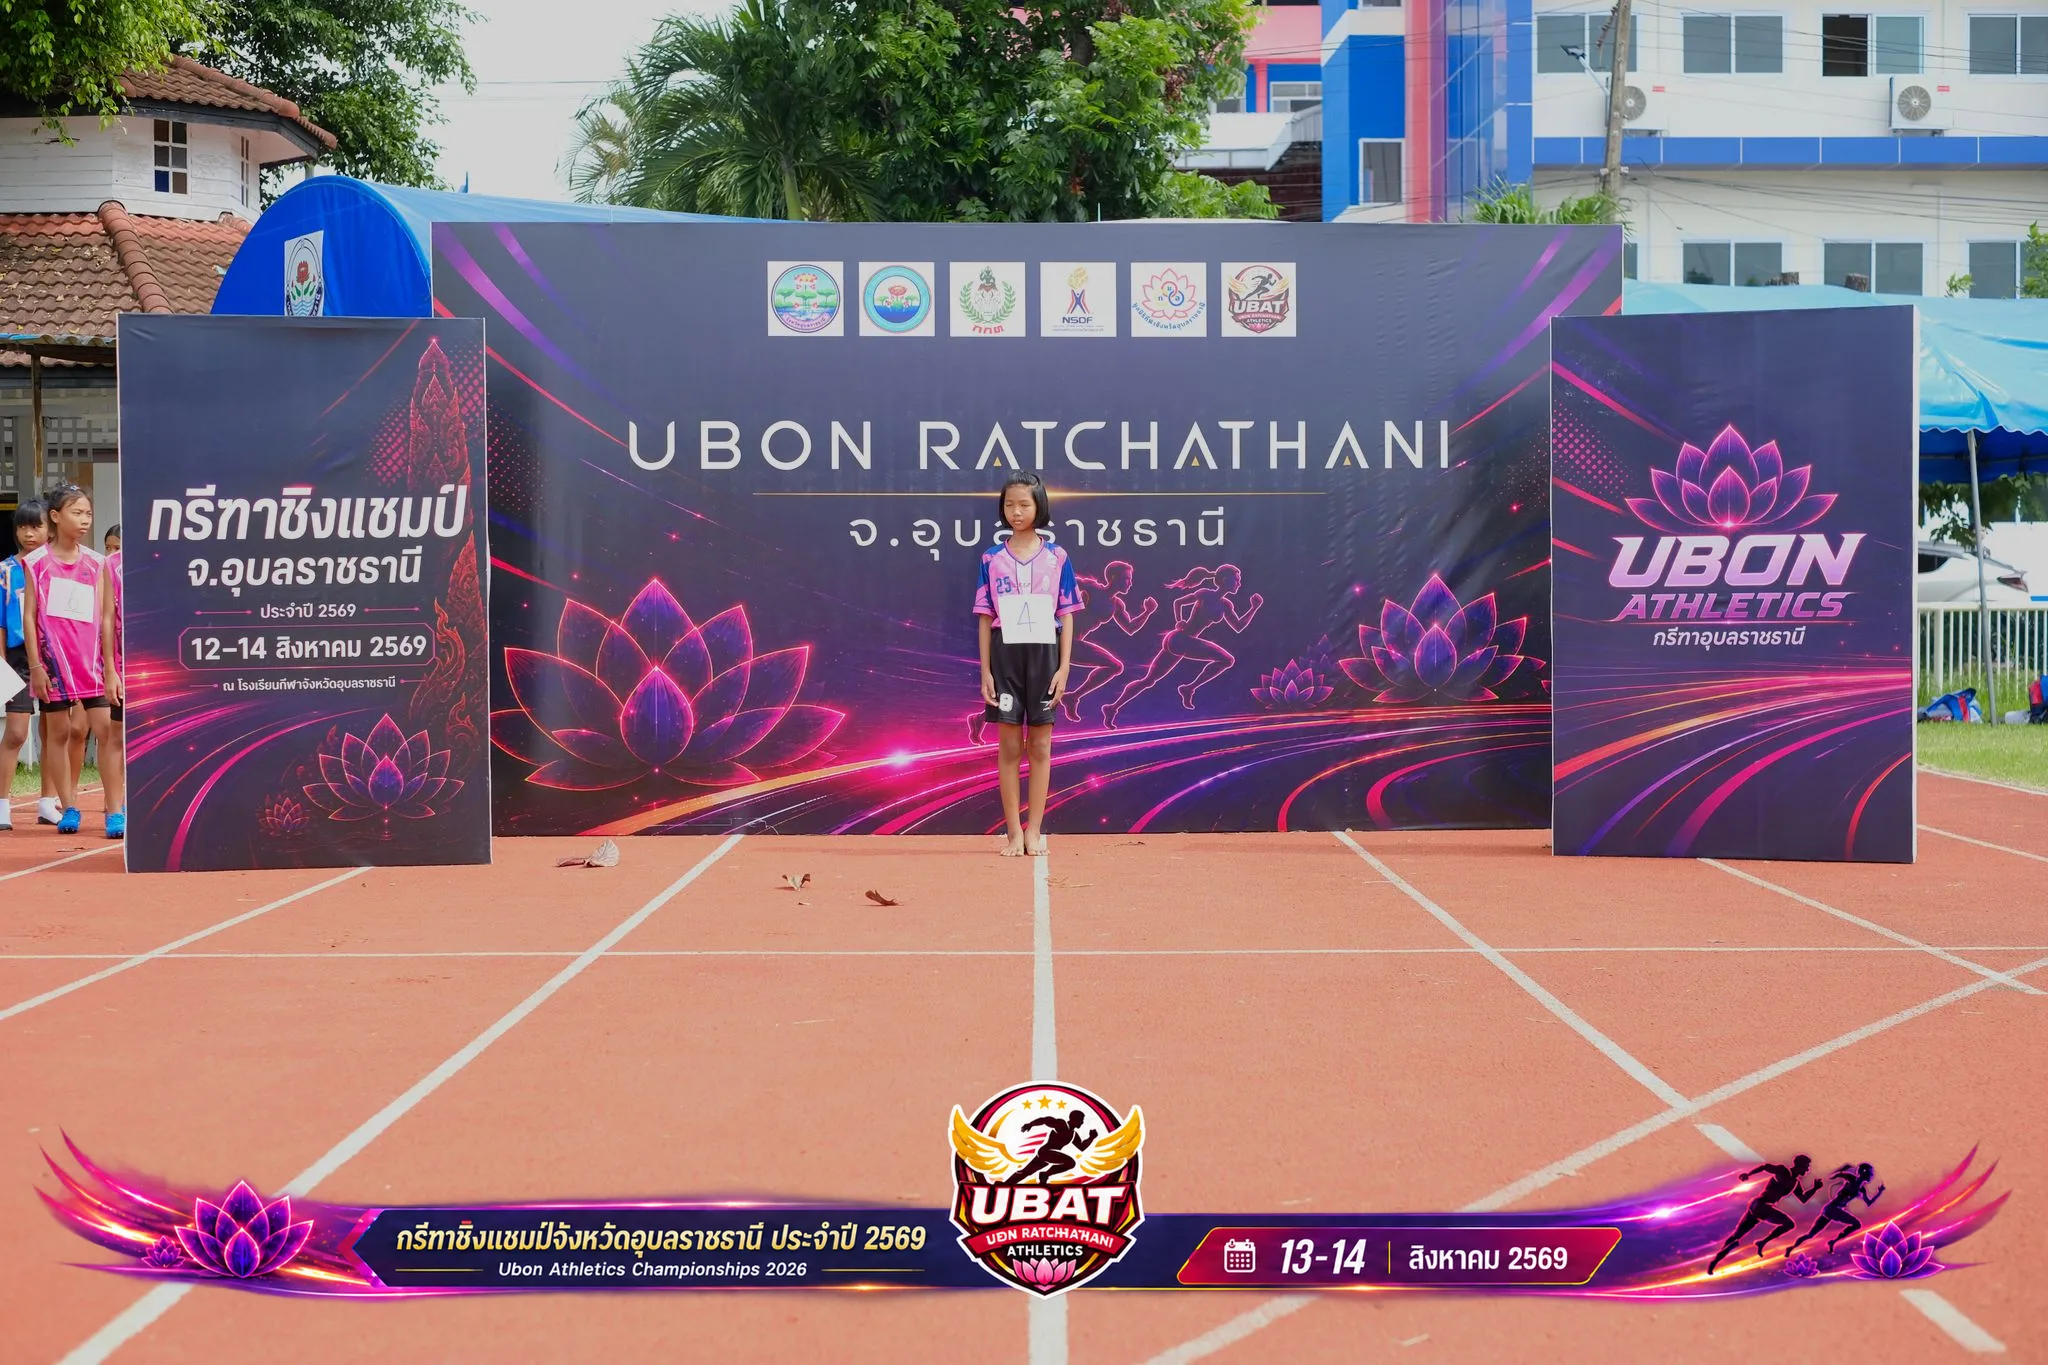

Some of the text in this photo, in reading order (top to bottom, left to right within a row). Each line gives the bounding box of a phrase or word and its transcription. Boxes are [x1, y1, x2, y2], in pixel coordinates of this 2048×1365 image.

[1232, 300, 1285, 315] UBAT
[1061, 316, 1093, 324] NSDF
[629, 421, 1449, 470] UBON RATCHATHANI
[148, 484, 468, 541] กรีฑาชิงแชมป์
[188, 545, 423, 598] จ.อุบลราชธานี
[1608, 534, 1867, 588] UBON
[996, 576, 1011, 594] 25
[260, 603, 357, 618] ประจำปี 2569
[1612, 592, 1849, 621] ATHLETICS
[275, 636, 362, 659] สิงหาคม
[369, 635, 427, 657] 2569
[1653, 626, 1807, 651] กรีฑาอุบลราชธานี
[222, 675, 396, 693] ณ โรงเรียนกีฬาจังหวัดอุบลราชธานี
